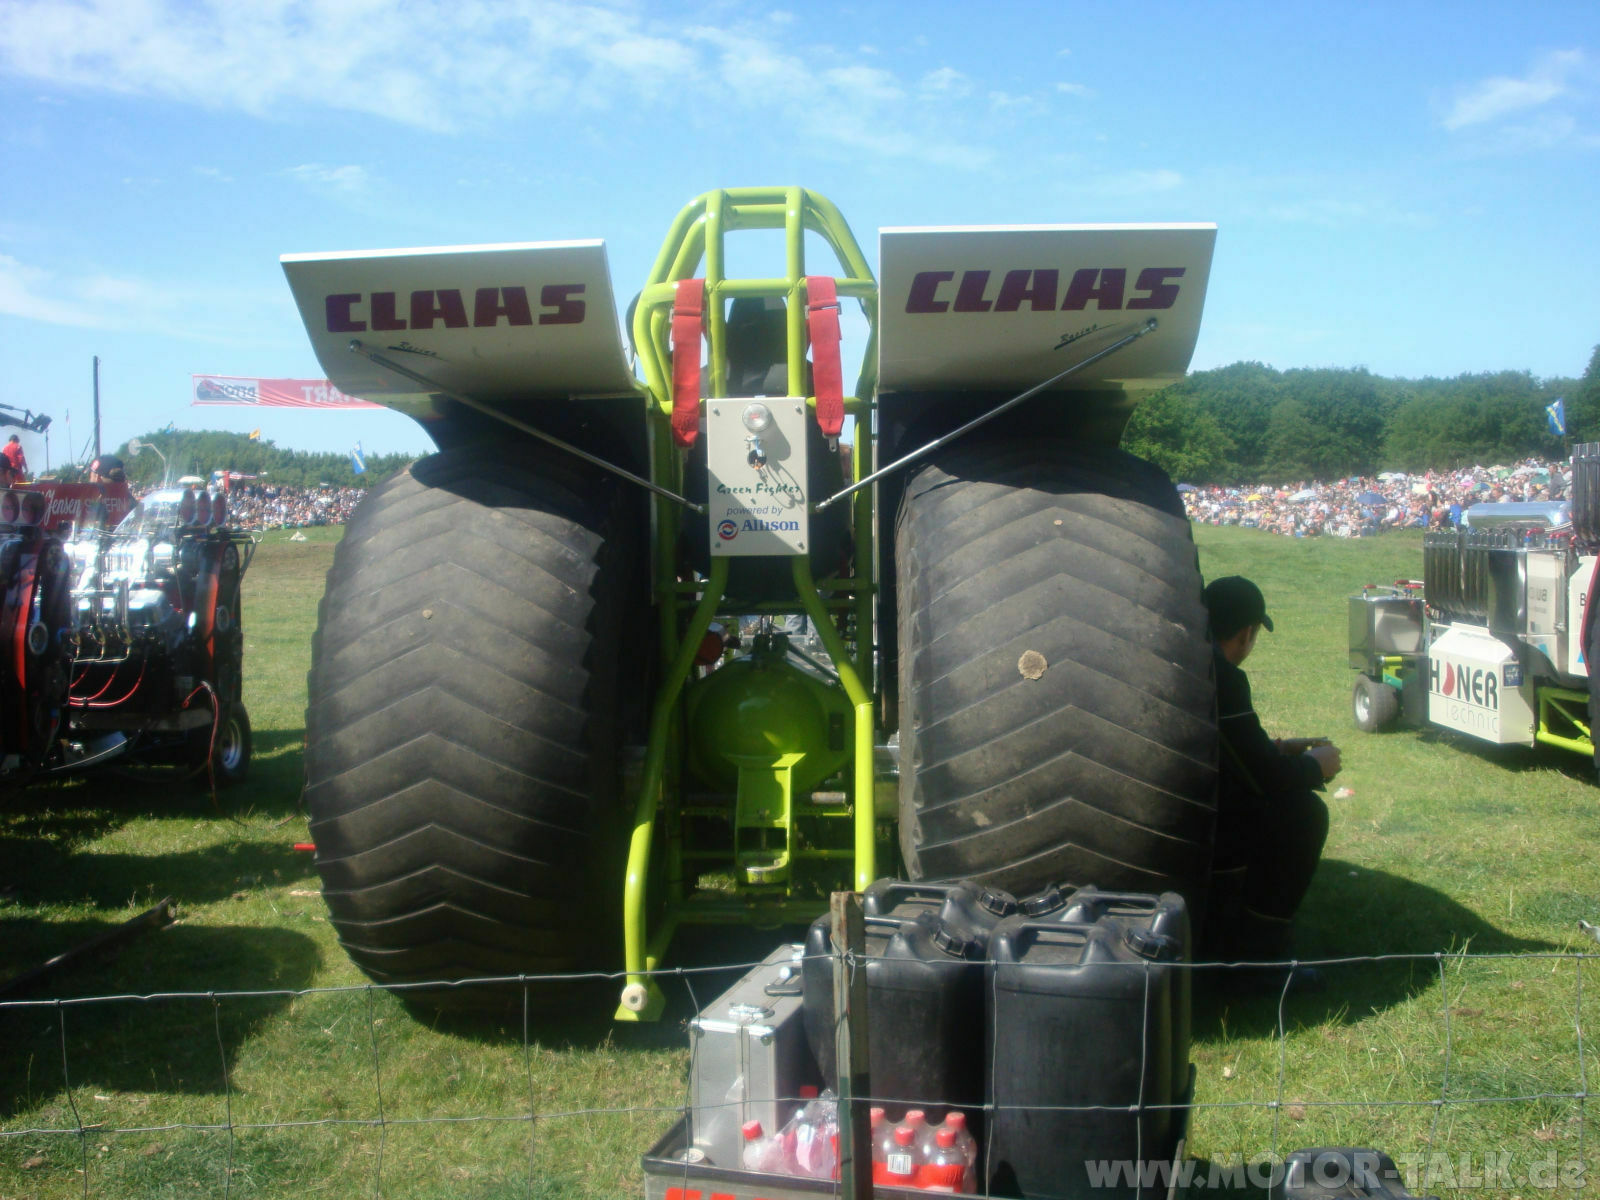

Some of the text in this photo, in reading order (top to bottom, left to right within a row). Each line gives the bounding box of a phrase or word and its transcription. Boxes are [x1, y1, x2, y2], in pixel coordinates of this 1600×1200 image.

[905, 267, 1186, 313] CLAAS
[325, 283, 586, 332] CLAAS
[717, 483, 801, 496] Green Fighter
[727, 505, 783, 516] powered by
[741, 519, 800, 532] Allison
